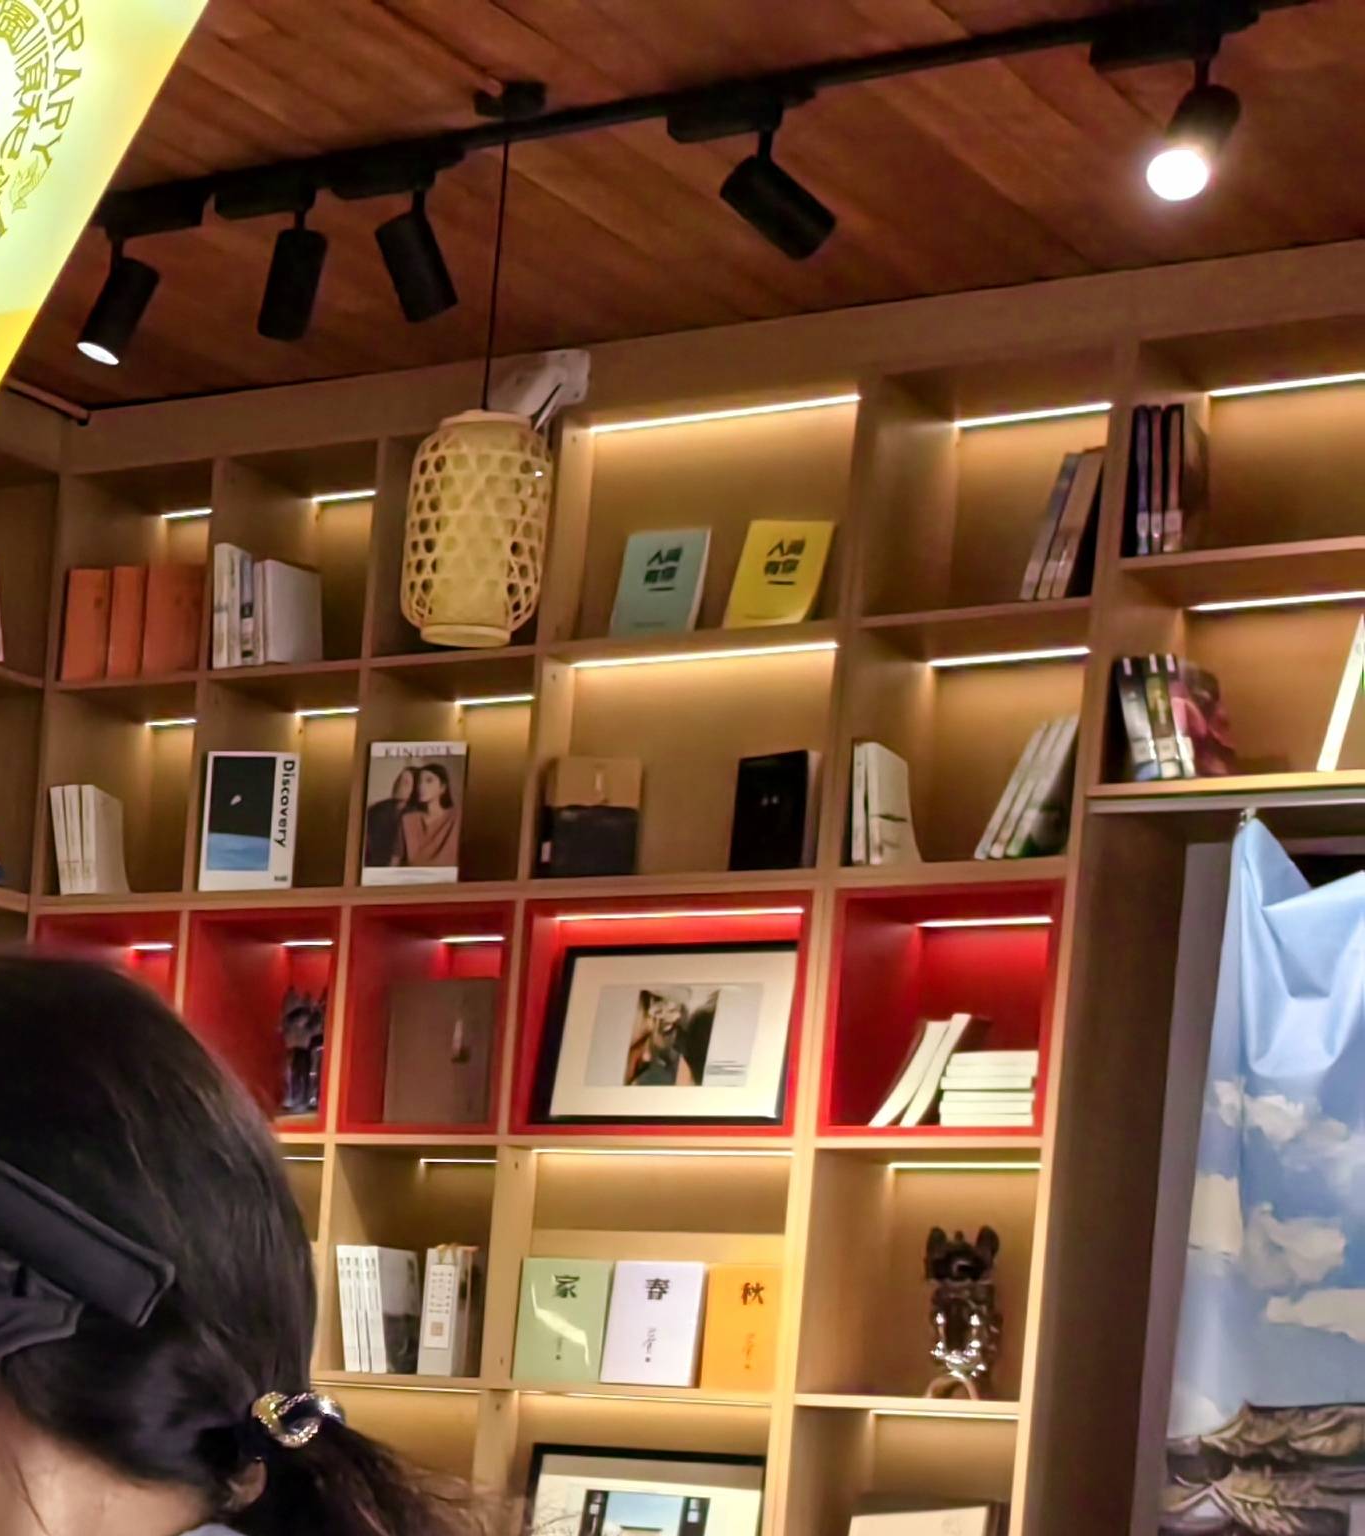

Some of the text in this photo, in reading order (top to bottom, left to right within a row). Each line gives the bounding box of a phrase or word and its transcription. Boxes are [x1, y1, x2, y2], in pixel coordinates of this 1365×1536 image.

[273, 760, 296, 848] Discovery
[554, 1274, 580, 1299] 家
[645, 1278, 671, 1301] 春
[741, 1282, 765, 1305] 秋
